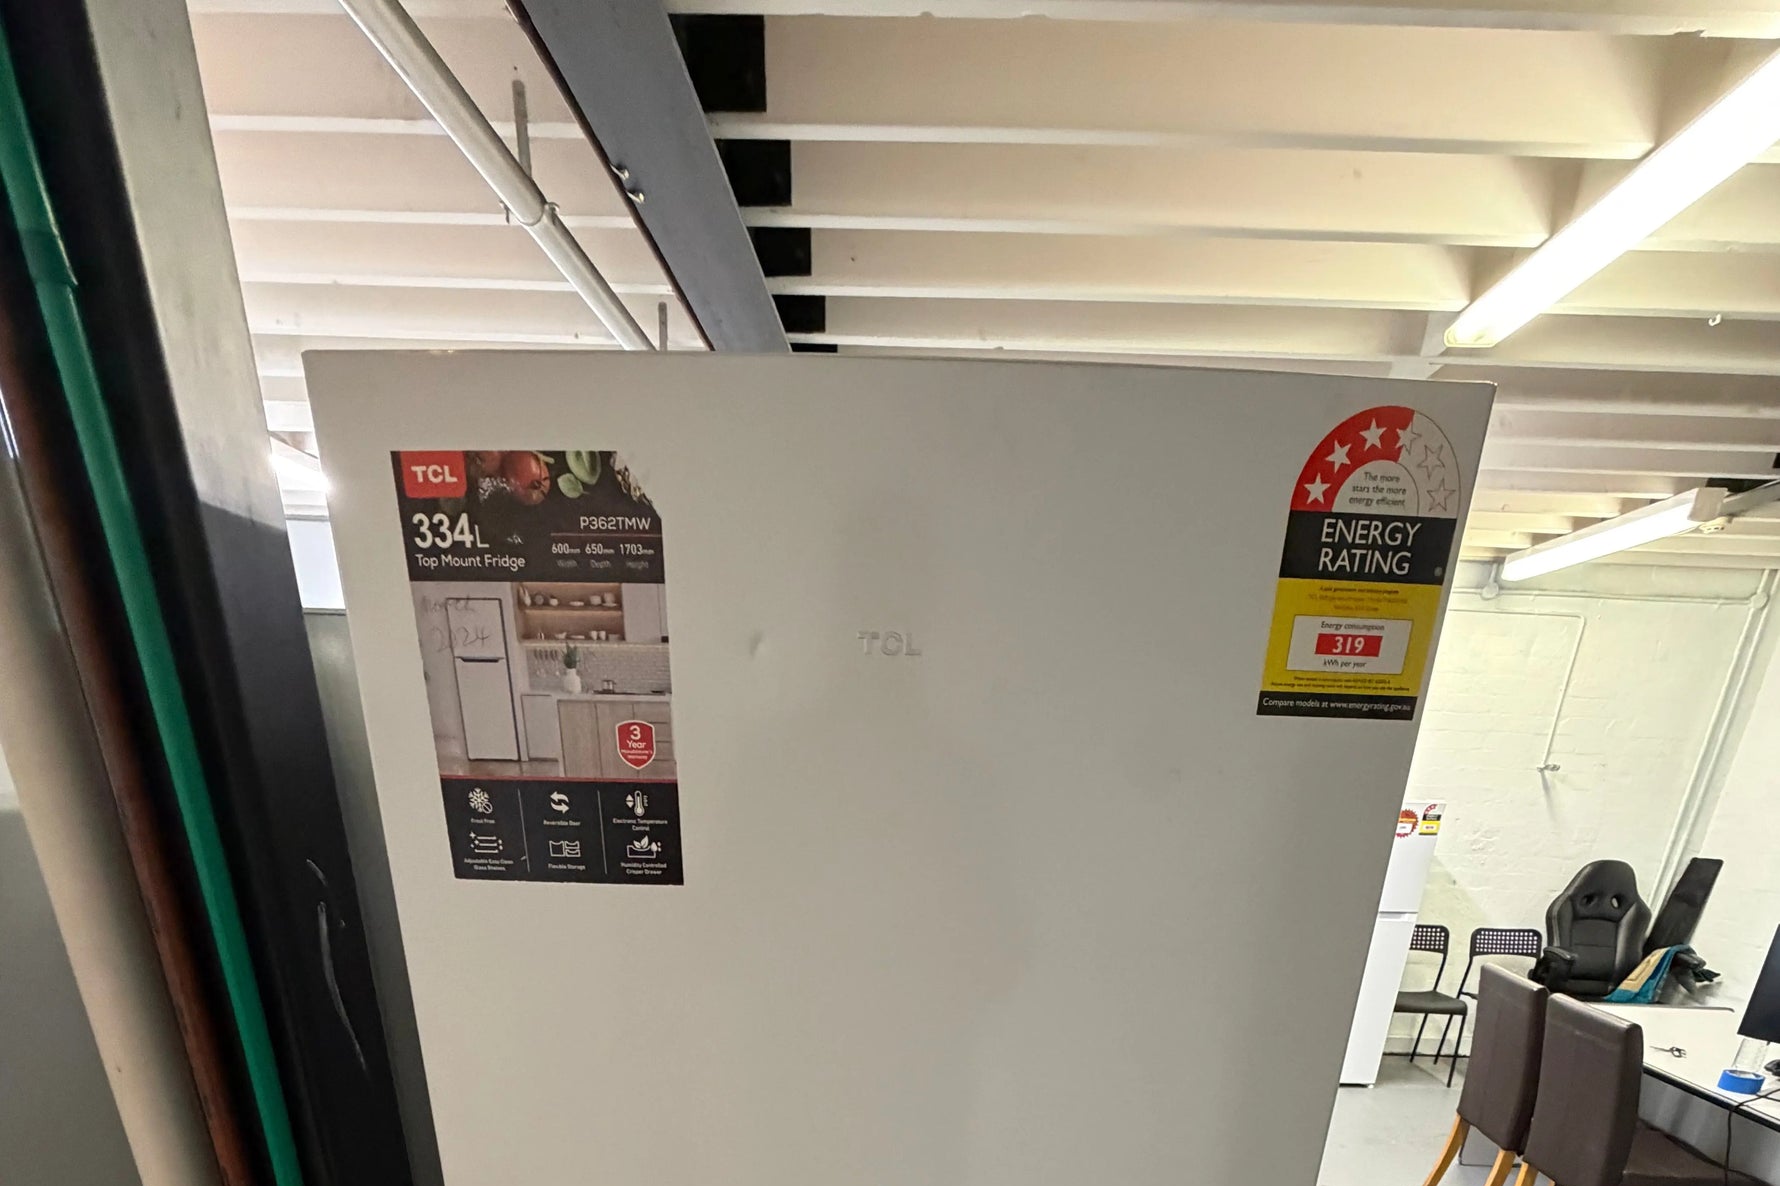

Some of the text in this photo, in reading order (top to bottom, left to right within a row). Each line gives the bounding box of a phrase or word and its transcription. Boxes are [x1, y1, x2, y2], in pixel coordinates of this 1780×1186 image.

[411, 464, 458, 484] TCL
[1364, 472, 1400, 482] The more
[1352, 485, 1406, 495] stars the more
[1348, 497, 1406, 507] energy efficient
[580, 516, 651, 531] P362TMW
[1321, 518, 1422, 547] ENERGY
[415, 554, 526, 571] Top Mount Fridge
[1318, 548, 1412, 575] RATING
[1321, 621, 1384, 632] Energy consumption
[857, 630, 922, 656] TCL
[1332, 636, 1365, 654] 319
[1323, 658, 1367, 669] kWh per year
[1262, 697, 1295, 708] Compare
[1296, 699, 1320, 708] models
[1330, 701, 1411, 713] www.energyrating.gov.au
[629, 725, 641, 740] 3
[626, 740, 647, 749] Year
